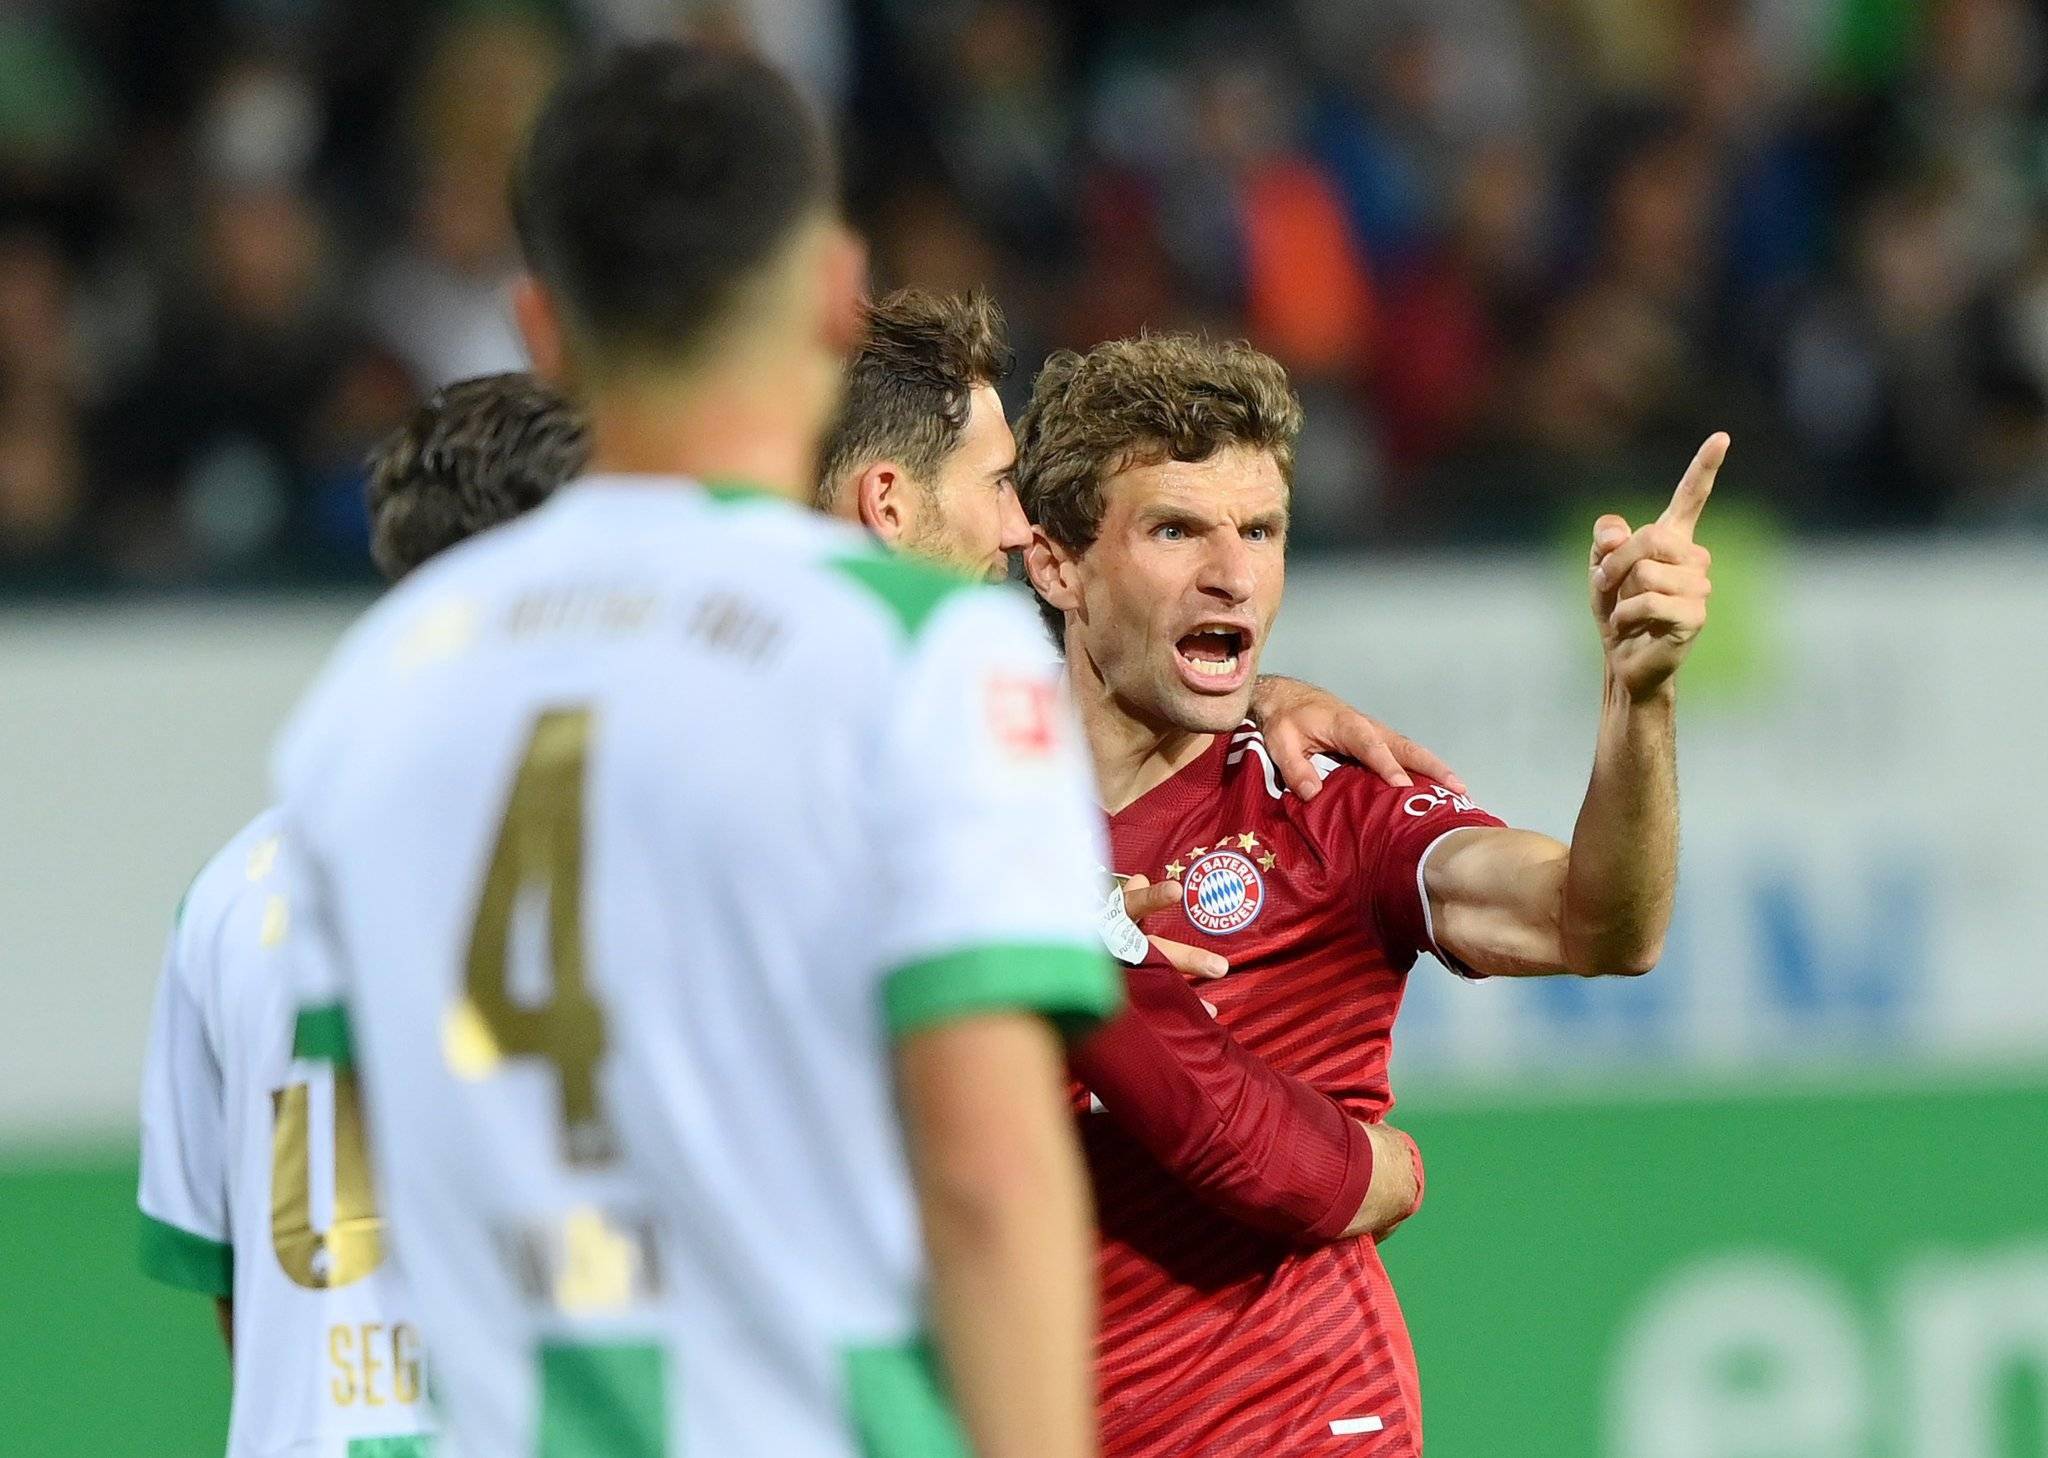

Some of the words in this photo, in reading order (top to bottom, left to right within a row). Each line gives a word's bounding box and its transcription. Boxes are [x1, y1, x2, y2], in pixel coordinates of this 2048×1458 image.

[1188, 871, 1203, 891] FC
[1202, 856, 1257, 886] BAYERN
[443, 704, 616, 1164] 4
[328, 1322, 424, 1407] SEG
